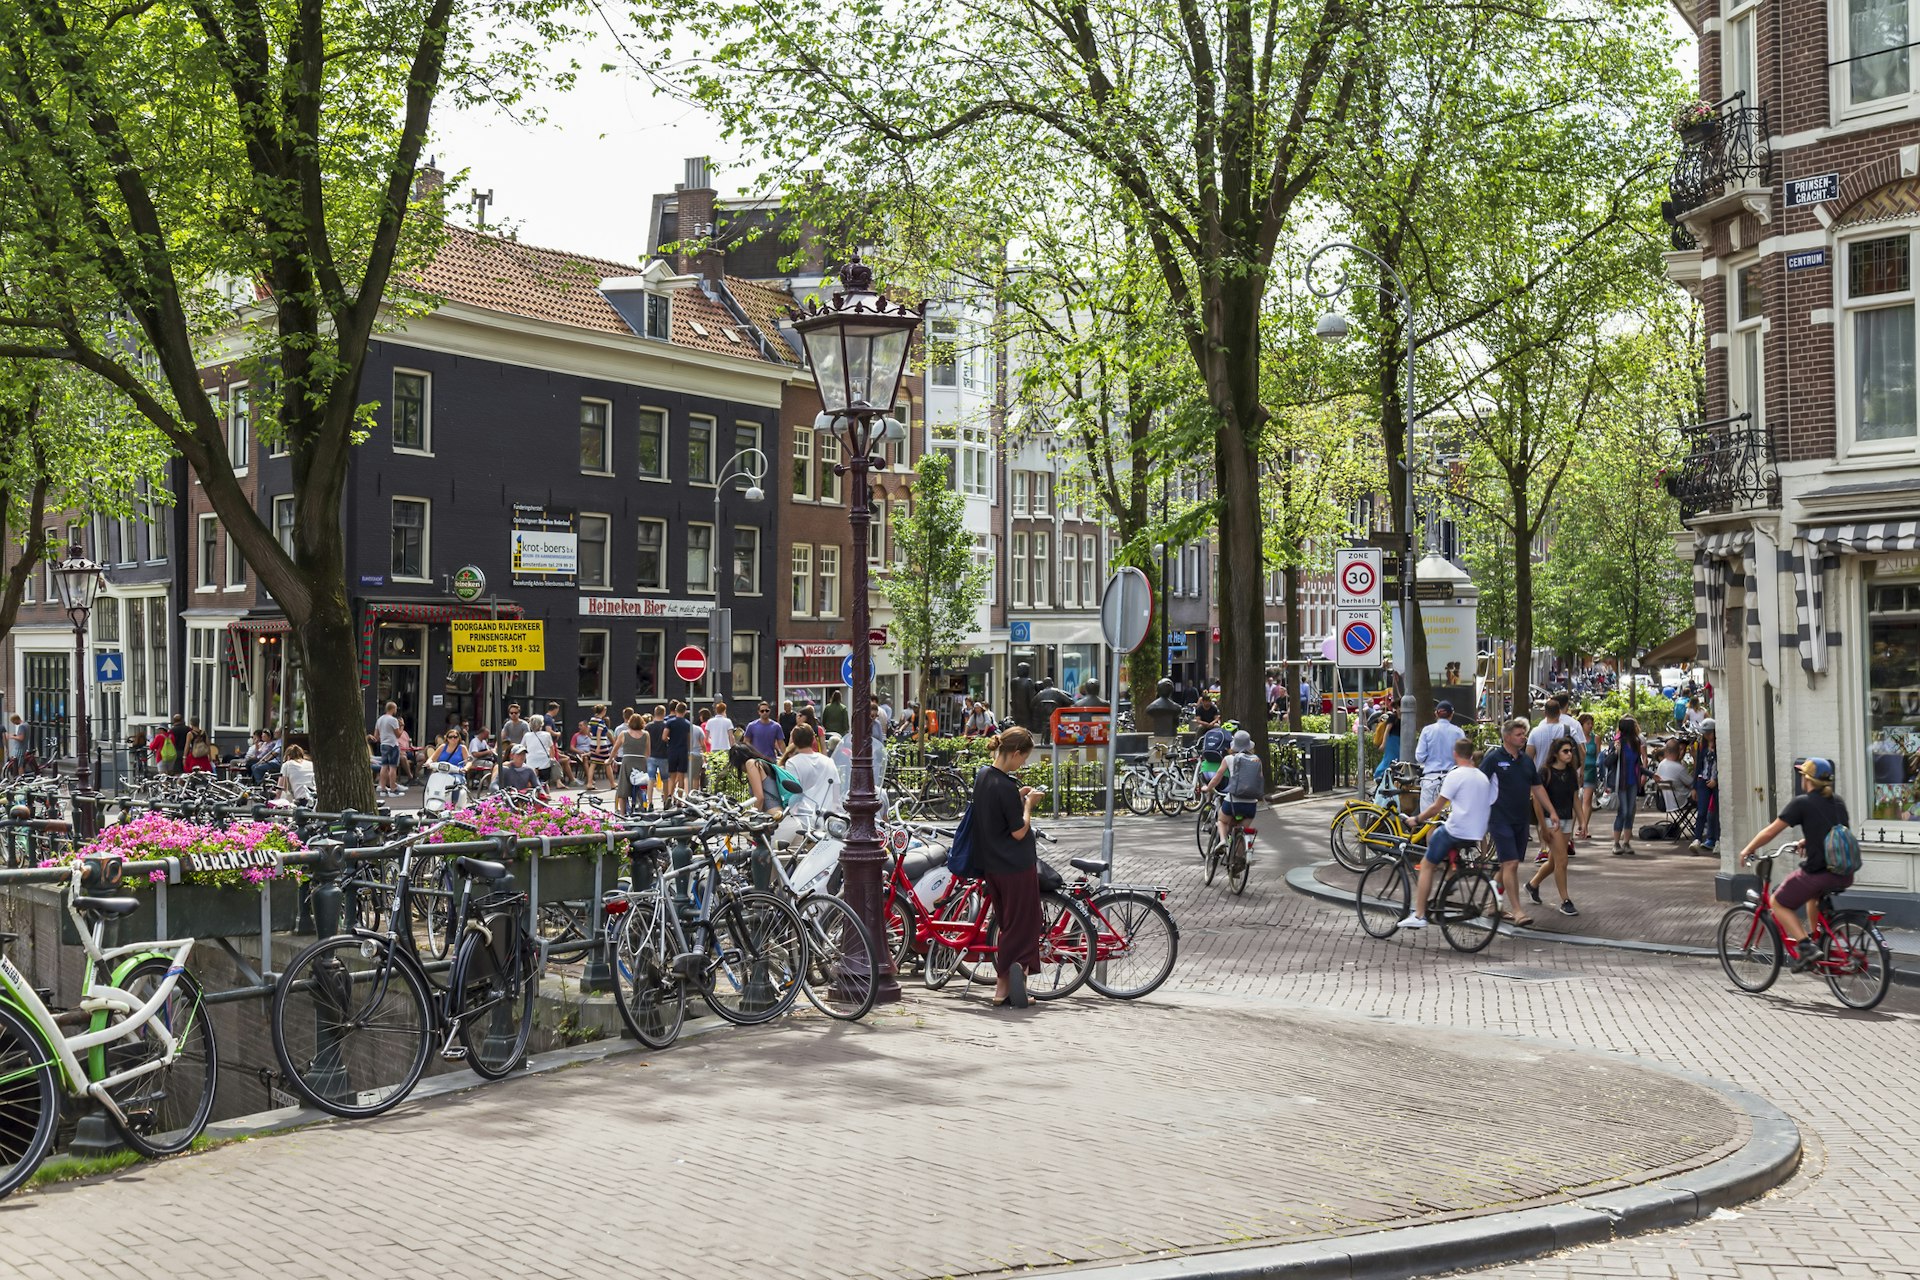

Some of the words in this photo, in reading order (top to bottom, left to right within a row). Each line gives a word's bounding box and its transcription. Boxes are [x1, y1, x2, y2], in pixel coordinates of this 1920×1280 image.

[1794, 177, 1832, 193] PRINSEN-
[1796, 189, 1830, 203] GRACHT.
[1789, 253, 1822, 268] CENTRUM
[1348, 572, 1369, 585] 30
[588, 598, 641, 615] Heineken
[643, 599, 667, 615] Bier
[454, 623, 497, 631] DOORGAAND
[498, 622, 541, 631] RIJVERKEER
[469, 633, 527, 641] PRINSENGRACHT
[457, 645, 476, 653] EVEN
[499, 645, 510, 653] TS.
[806, 645, 826, 655] INGER
[480, 658, 518, 667] GESTREMD
[189, 849, 278, 872] BERENSLUIS
